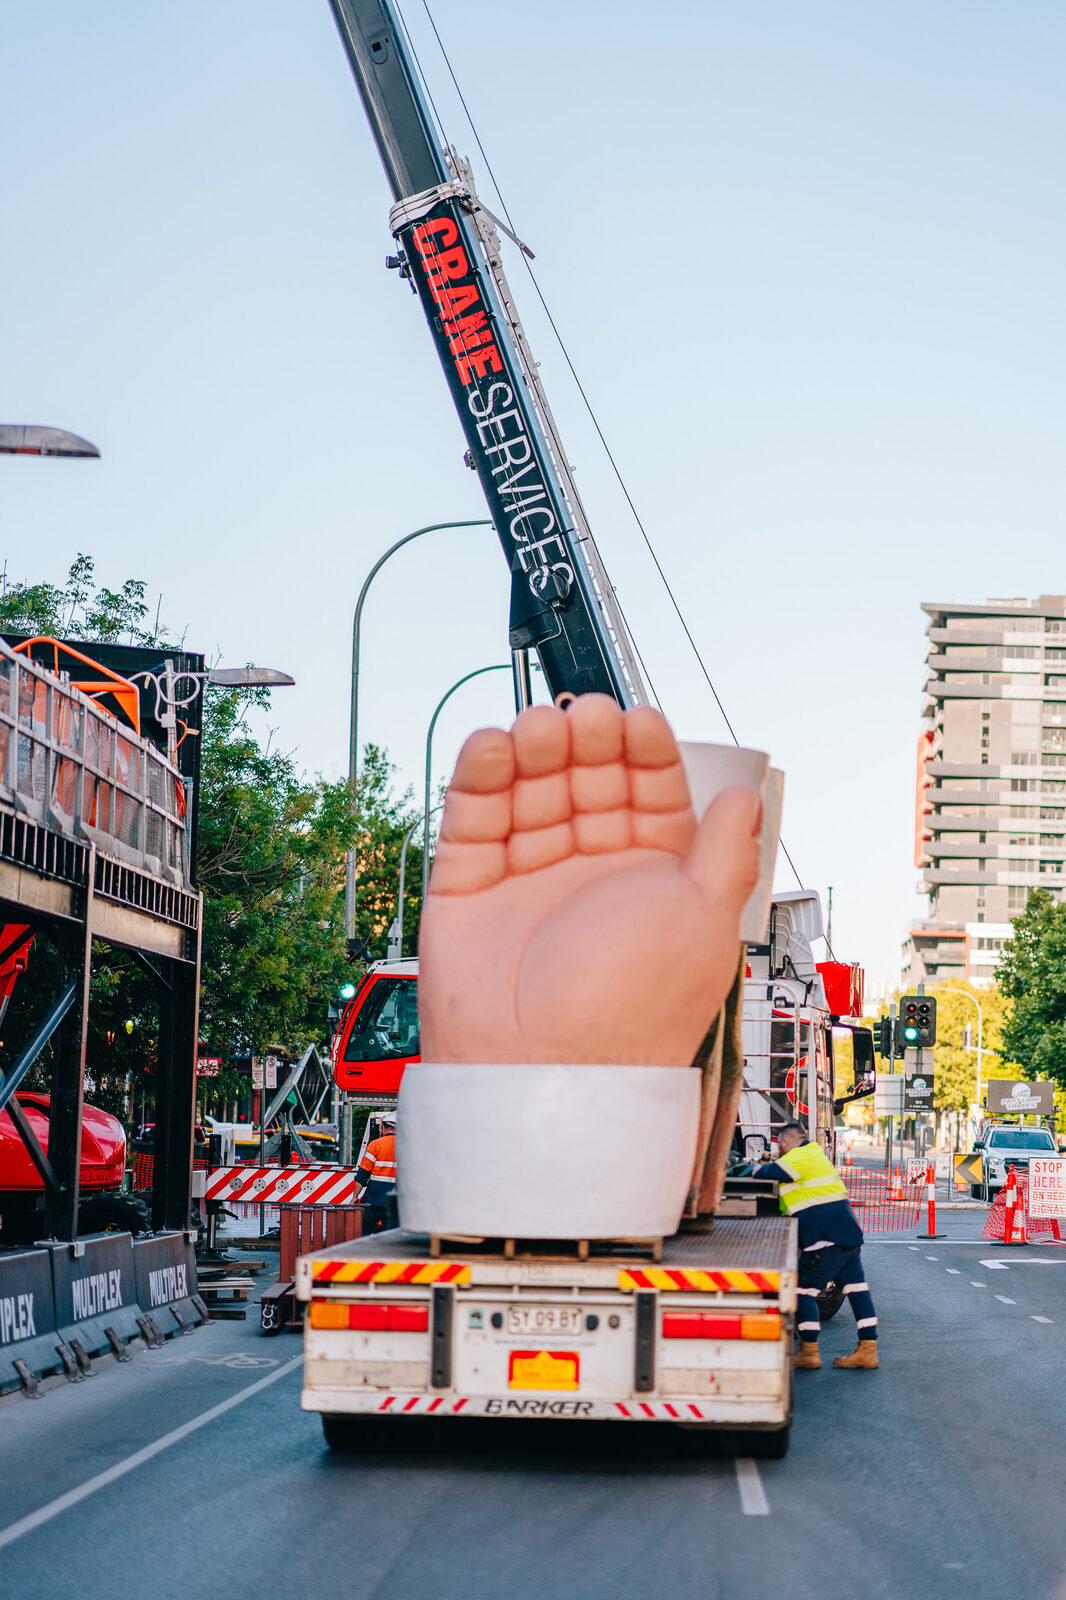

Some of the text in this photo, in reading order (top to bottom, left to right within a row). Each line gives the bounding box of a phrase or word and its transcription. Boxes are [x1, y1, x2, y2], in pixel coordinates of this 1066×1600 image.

[413, 217, 575, 598] CRANE SERVICES
[1034, 1161, 1063, 1173] STOP
[1033, 1176, 1063, 1188] HERE
[1032, 1191, 1065, 1201] ON RED
[1031, 1203, 1065, 1214] SIGNAL
[149, 1263, 188, 1307] MULTIPLEX
[72, 1269, 123, 1321] MULTIPLEX
